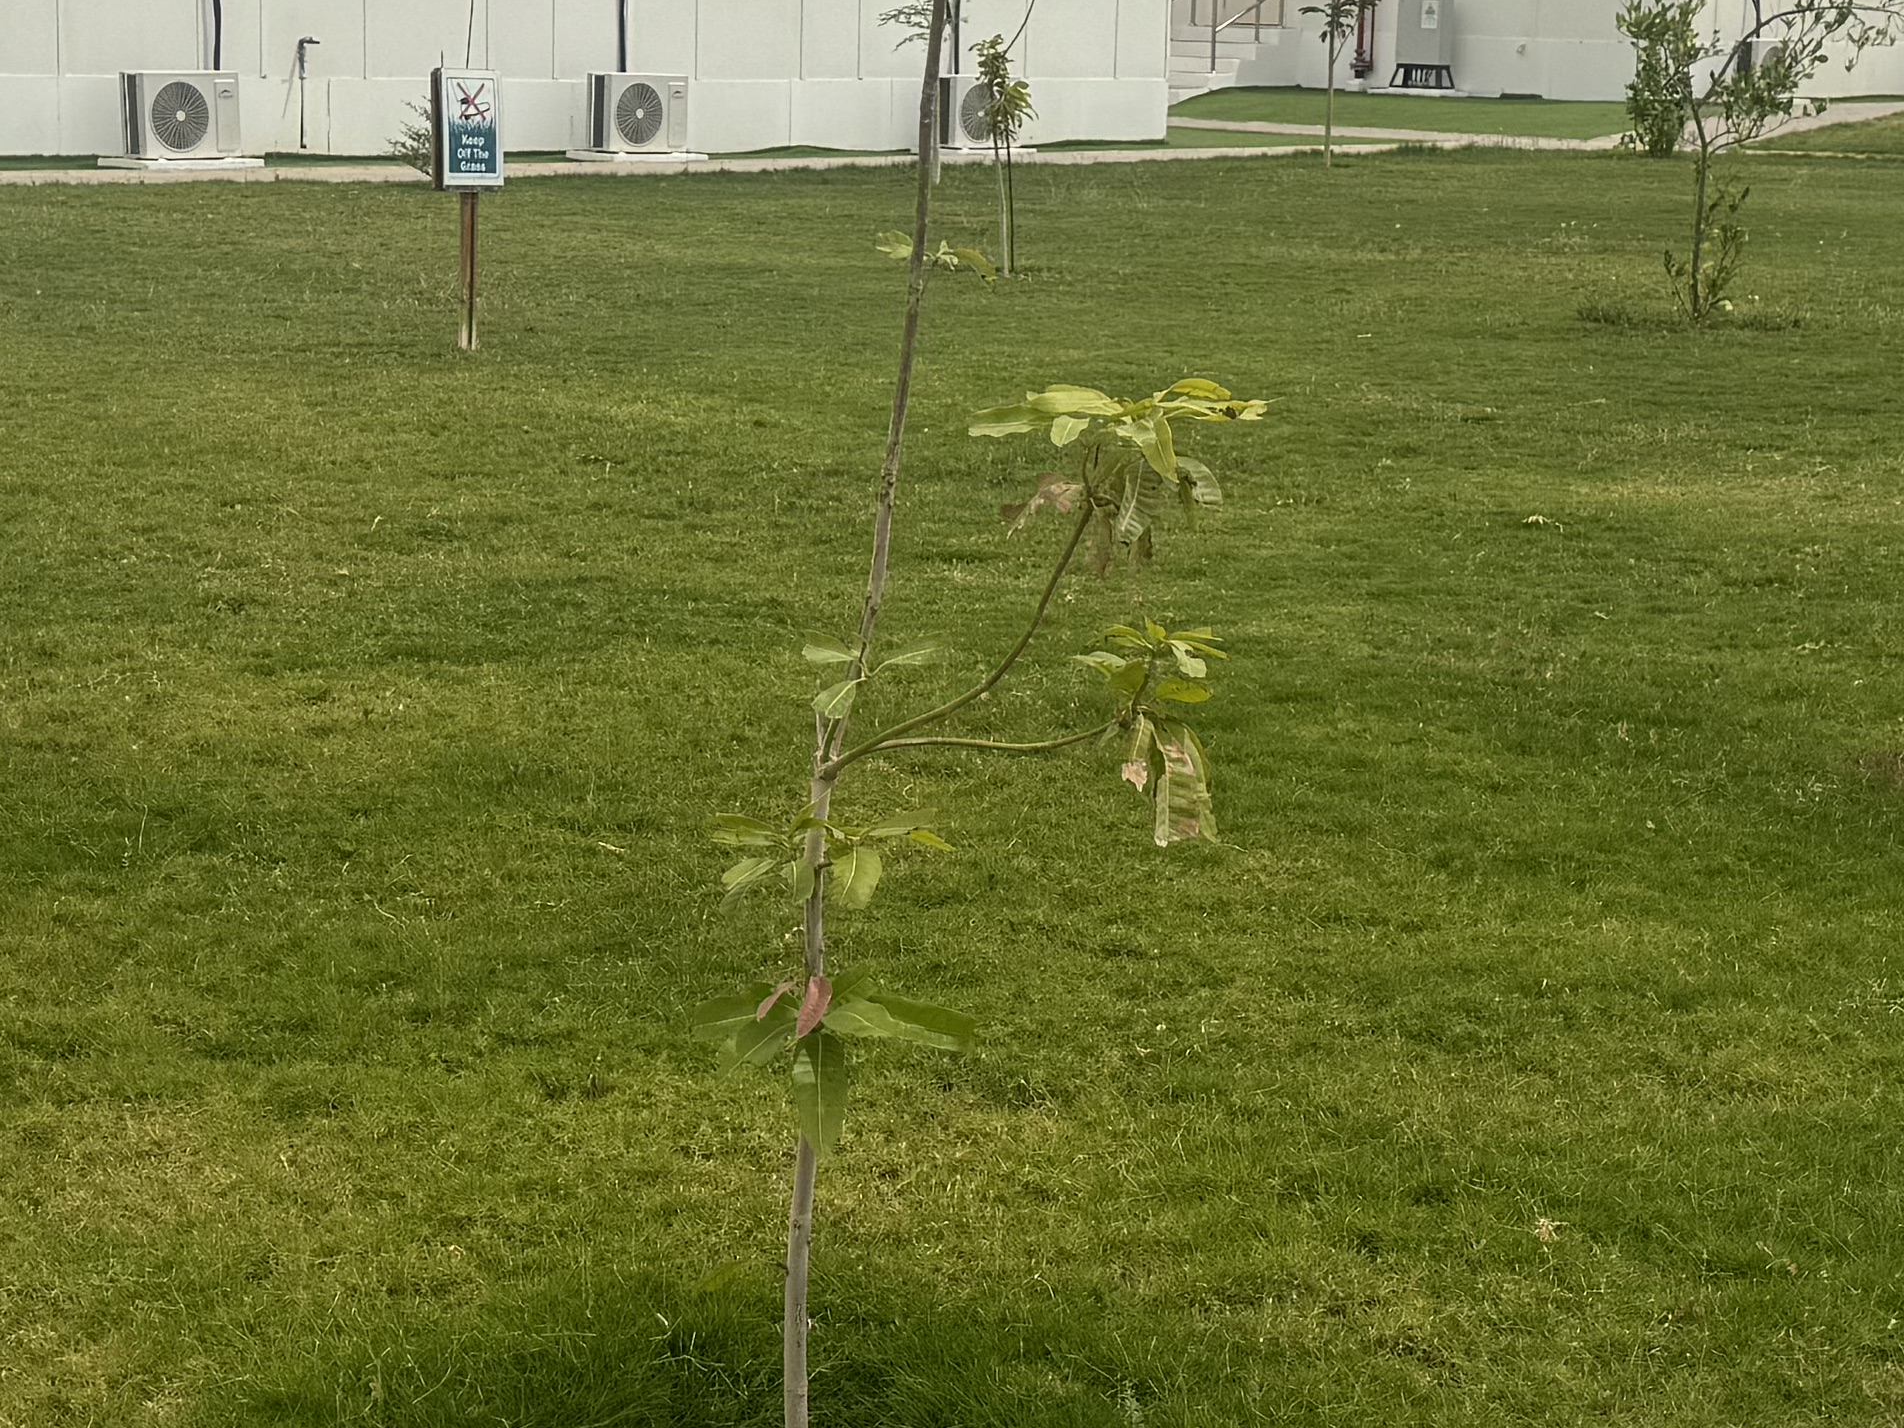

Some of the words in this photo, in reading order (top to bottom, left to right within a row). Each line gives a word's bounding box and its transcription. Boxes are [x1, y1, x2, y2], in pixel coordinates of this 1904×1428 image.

[461, 134, 485, 147] Keep
[473, 148, 490, 159] The
[460, 160, 486, 172] Grass
